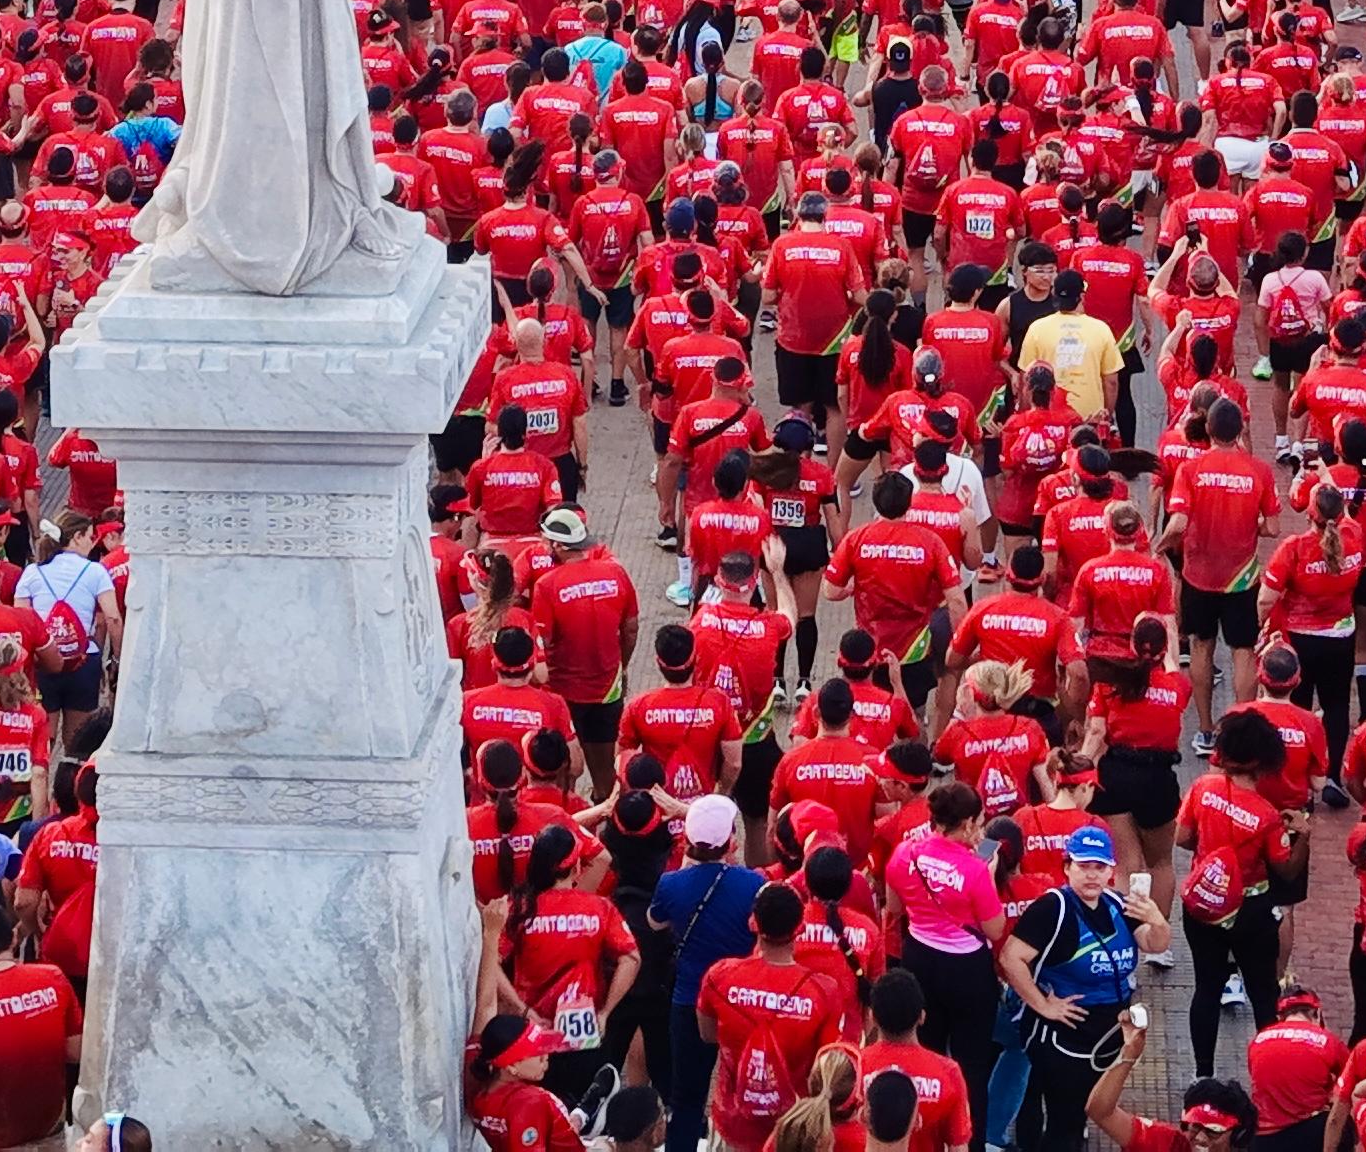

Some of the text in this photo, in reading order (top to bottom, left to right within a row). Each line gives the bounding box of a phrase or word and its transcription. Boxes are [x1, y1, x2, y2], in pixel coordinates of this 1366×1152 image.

[968, 218, 992, 232] 1322
[528, 412, 556, 429] 2037
[773, 501, 803, 519] 1359
[797, 764, 867, 780] CARTAGENA
[1202, 792, 1259, 828] CARTAGENA
[728, 987, 812, 1017] CARTAGENA
